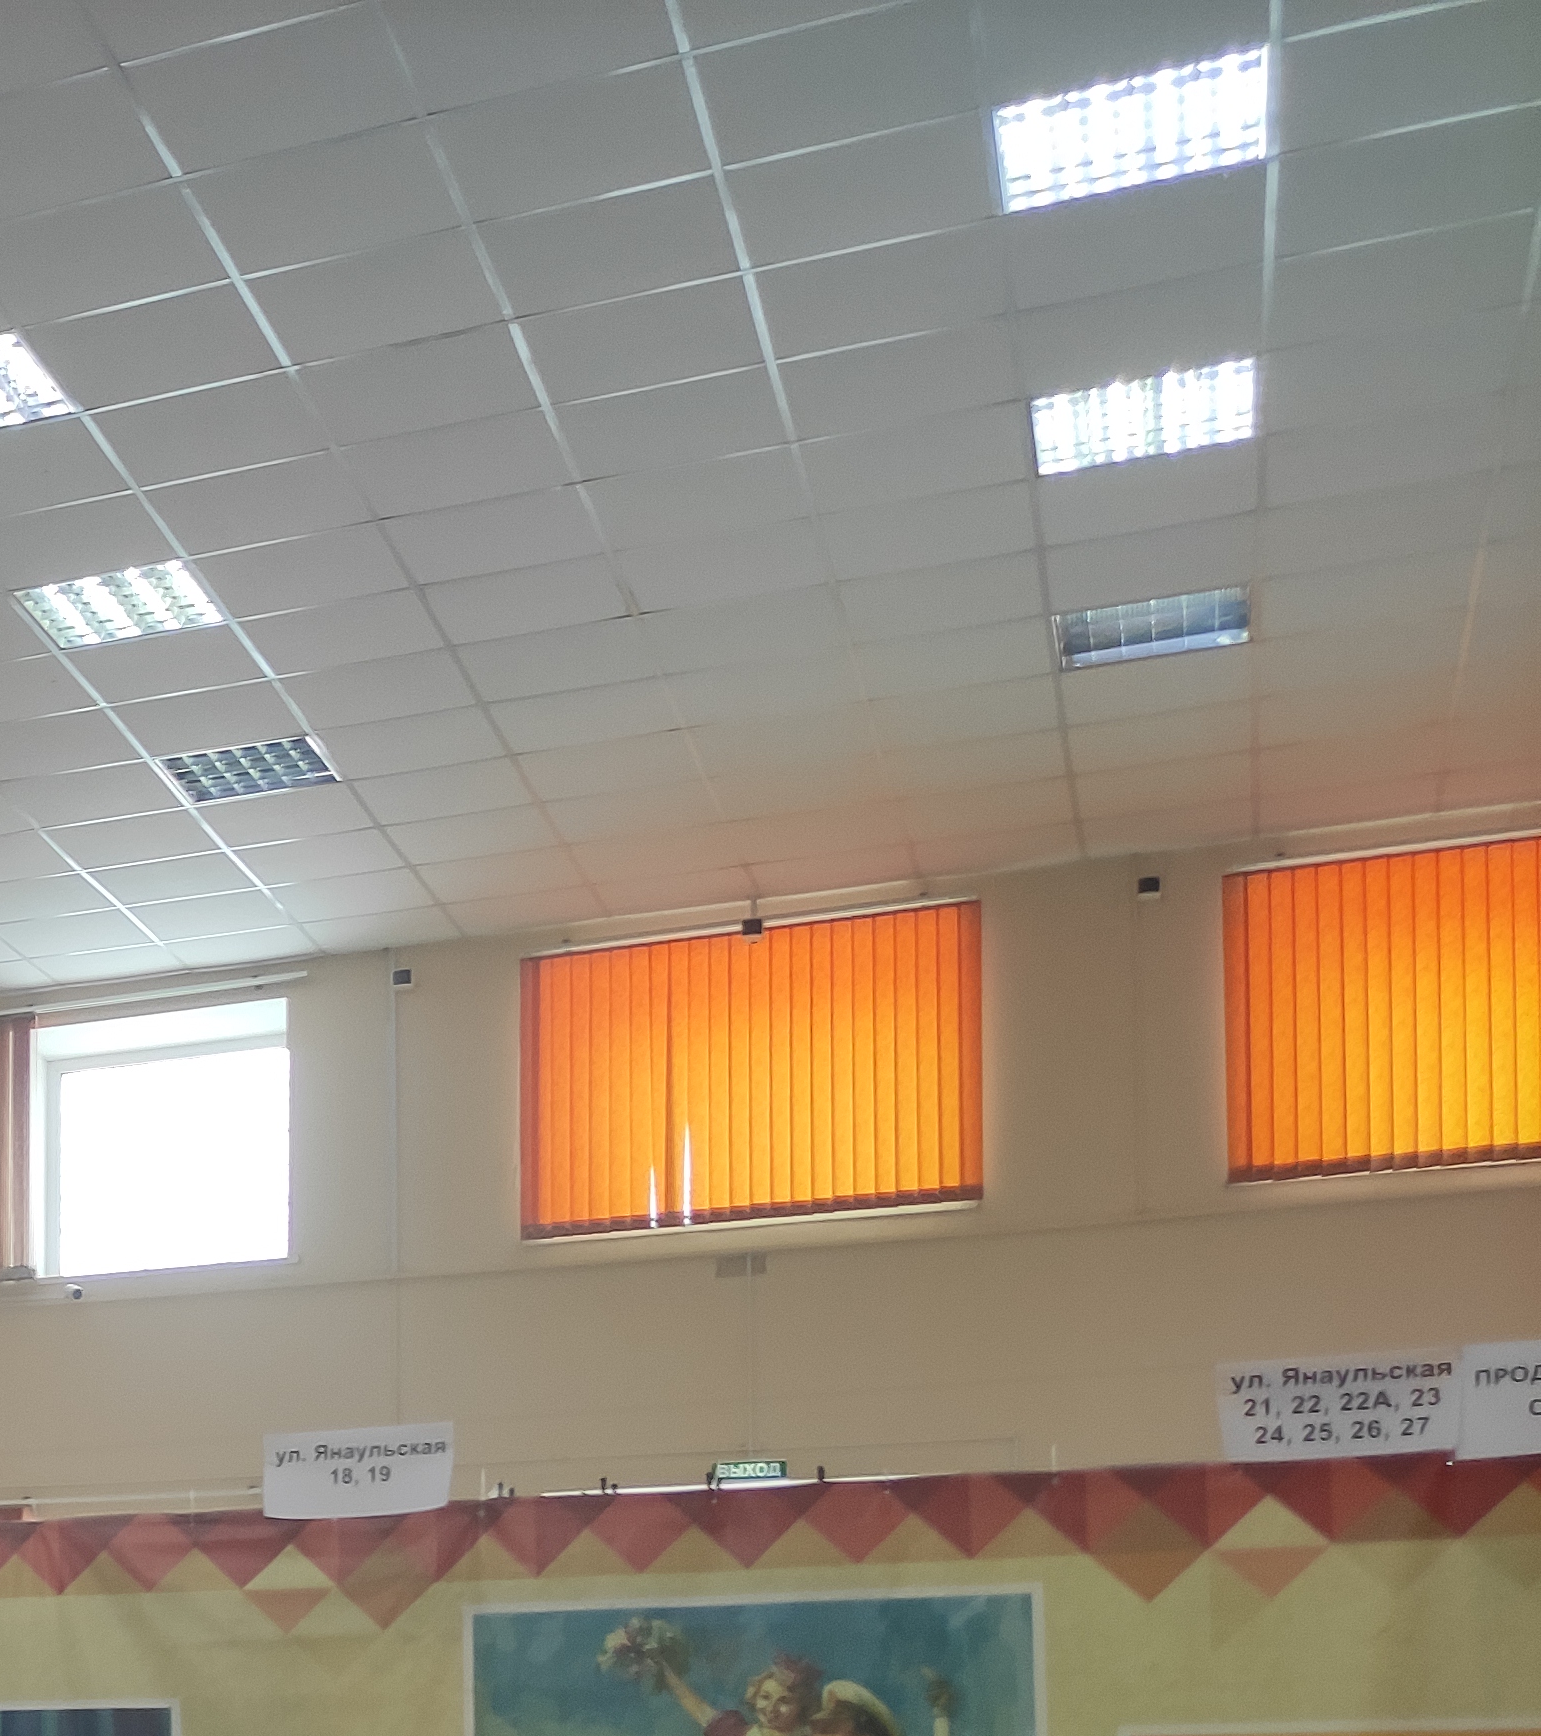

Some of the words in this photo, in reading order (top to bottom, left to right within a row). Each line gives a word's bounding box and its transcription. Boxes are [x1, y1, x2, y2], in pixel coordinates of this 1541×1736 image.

[1231, 1374, 1271, 1394] ул.
[1282, 1361, 1452, 1388] Янаульская
[1244, 1398, 1280, 1418] 21,
[1292, 1395, 1329, 1416] 22,
[1411, 1387, 1441, 1408] 23
[1255, 1425, 1292, 1446] 24,
[1302, 1423, 1340, 1443] 25,
[1351, 1420, 1389, 1441] 26,
[1400, 1417, 1430, 1437] 27
[275, 1450, 306, 1467] ул.
[314, 1441, 447, 1463] Янаульская
[330, 1467, 359, 1486] 18,
[368, 1466, 392, 1483] 19
[717, 1463, 781, 1477] ВЫХОД
